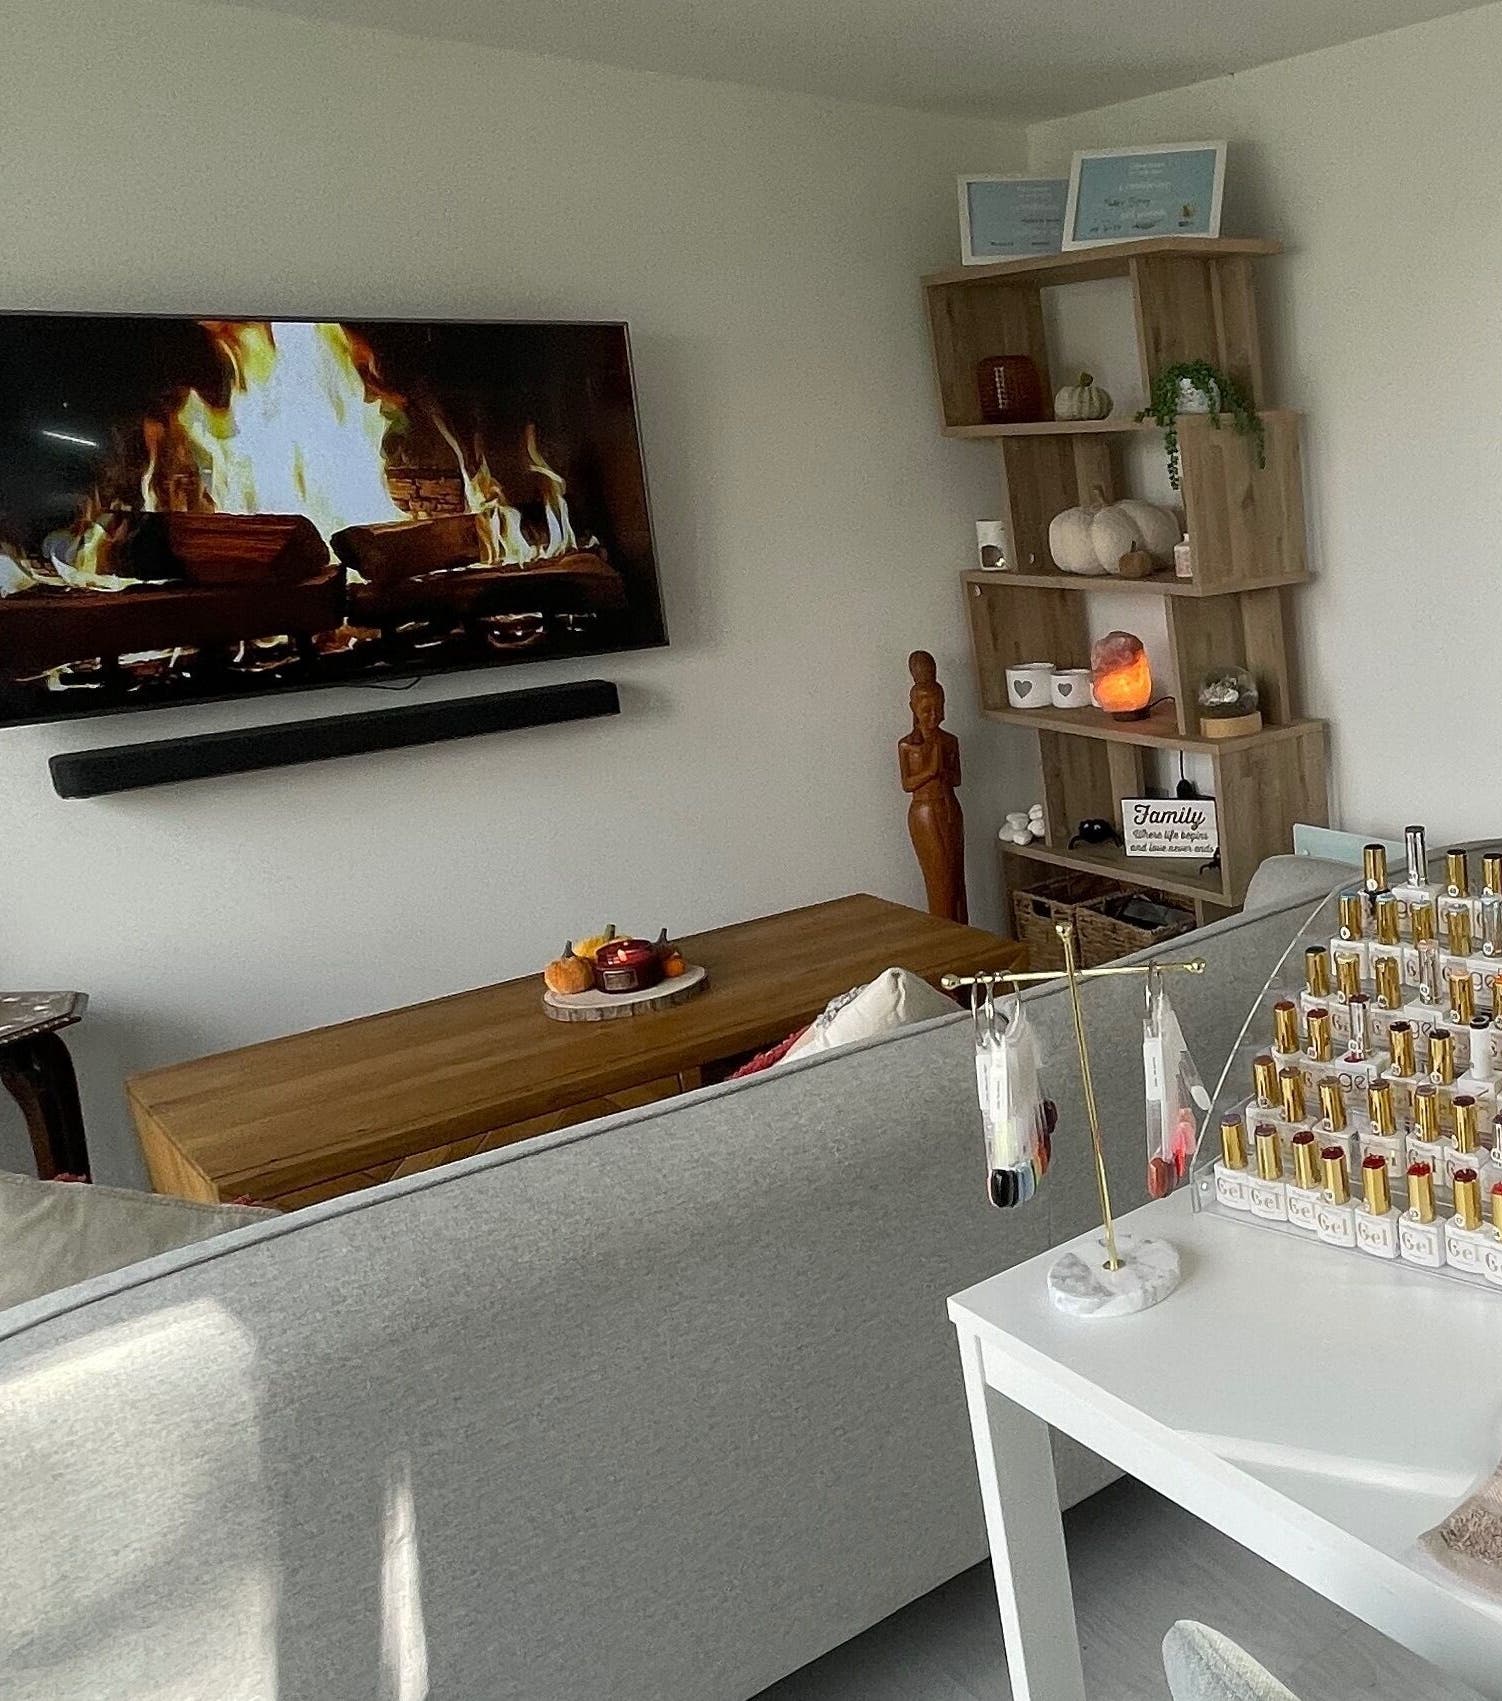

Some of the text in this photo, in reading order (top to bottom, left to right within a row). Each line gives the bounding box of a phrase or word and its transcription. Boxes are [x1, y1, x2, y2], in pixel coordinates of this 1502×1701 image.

[1133, 804, 1206, 831] Family
[1132, 829, 1209, 842] Where life begins
[1130, 844, 1147, 852] and
[1149, 844, 1167, 852] love
[1194, 844, 1214, 853] ends
[1217, 1176, 1245, 1200] Gel
[1251, 1188, 1281, 1210] Gel
[1289, 1197, 1316, 1221] Gel
[1318, 1212, 1348, 1236] Gel
[1358, 1222, 1388, 1246] Gel
[1402, 1231, 1433, 1256] Gel
[1448, 1238, 1480, 1262] Gel
